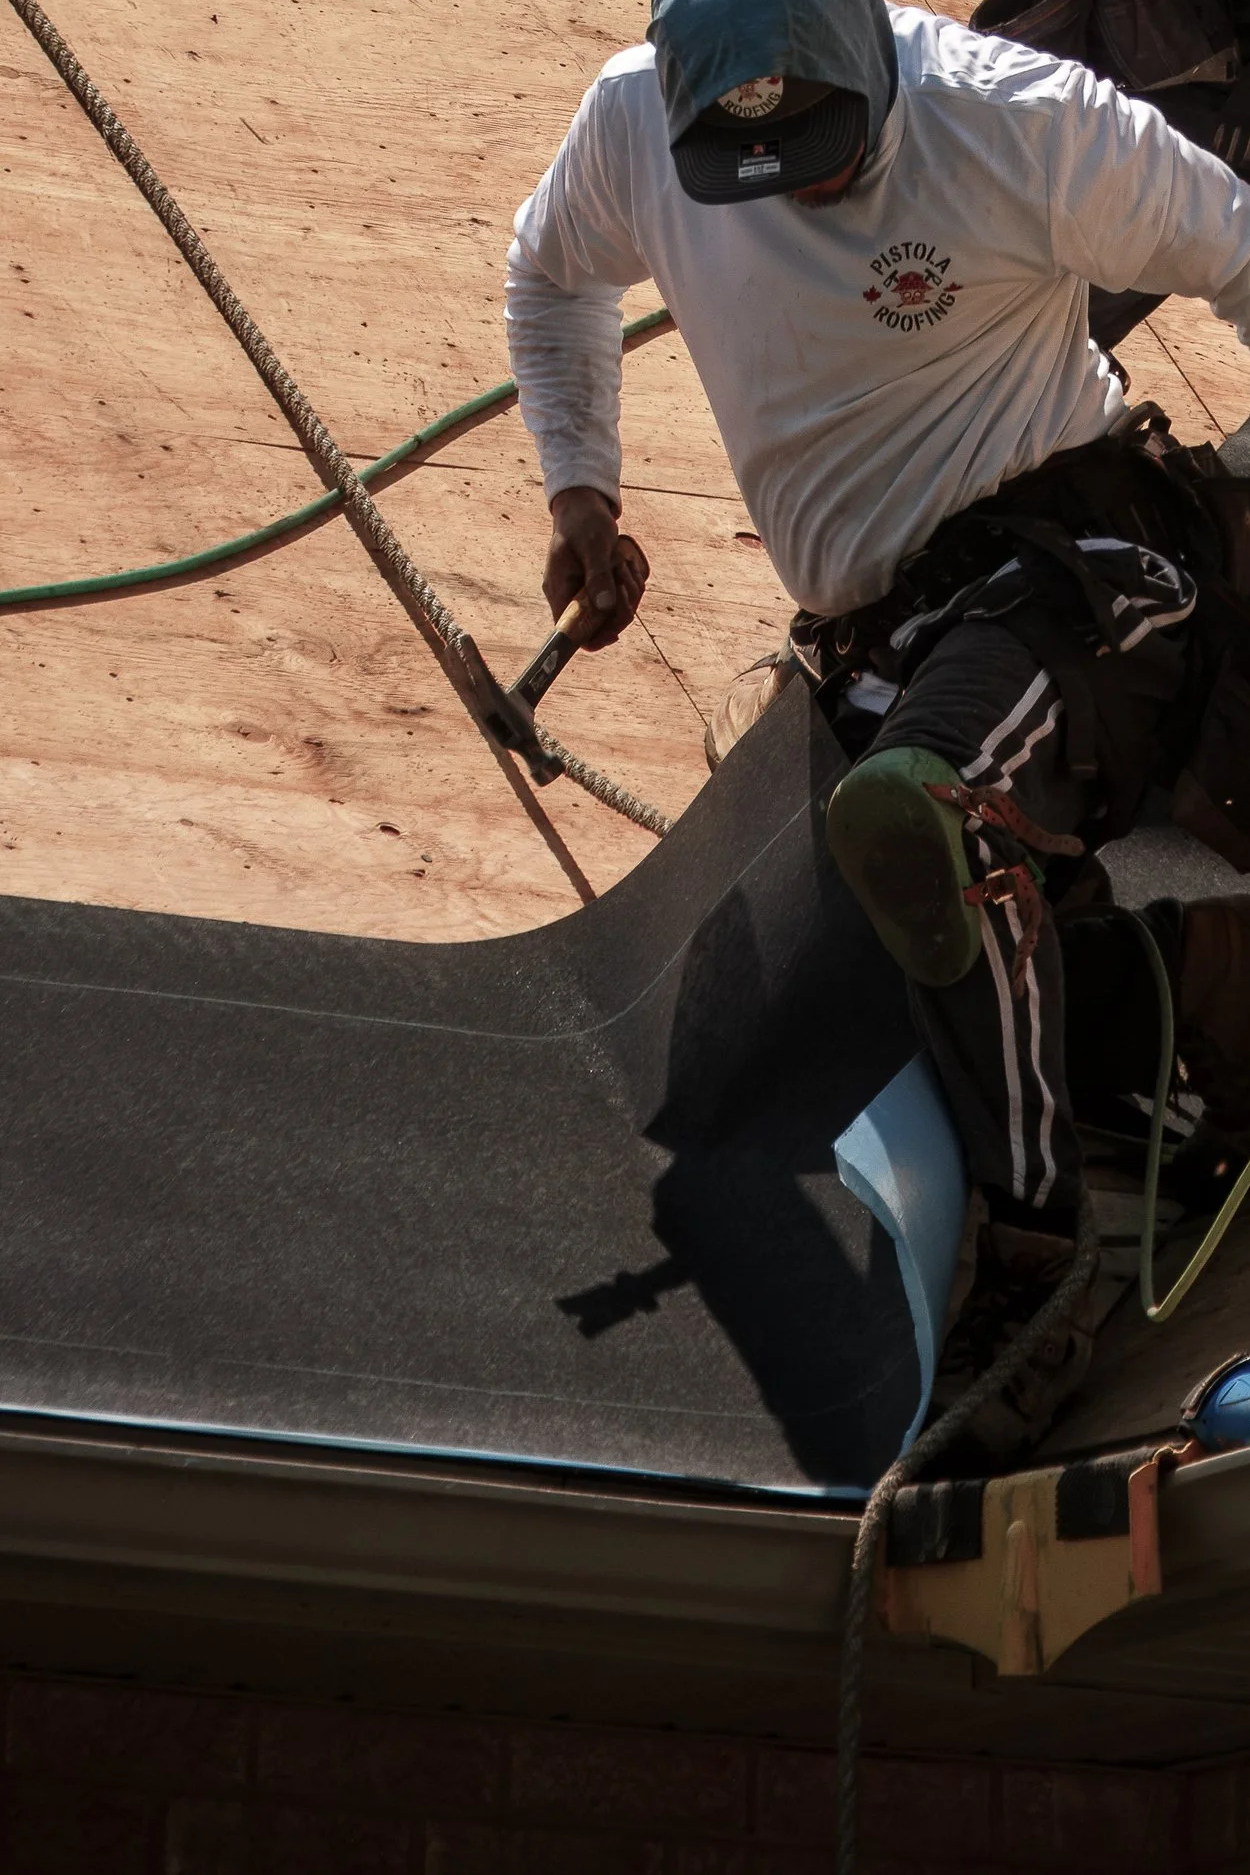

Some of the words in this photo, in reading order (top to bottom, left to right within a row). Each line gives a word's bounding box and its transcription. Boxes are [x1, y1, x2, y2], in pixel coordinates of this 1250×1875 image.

[723, 91, 781, 118] ROOFING
[869, 241, 952, 276] PISTOLA
[873, 292, 956, 333] ROOFING
